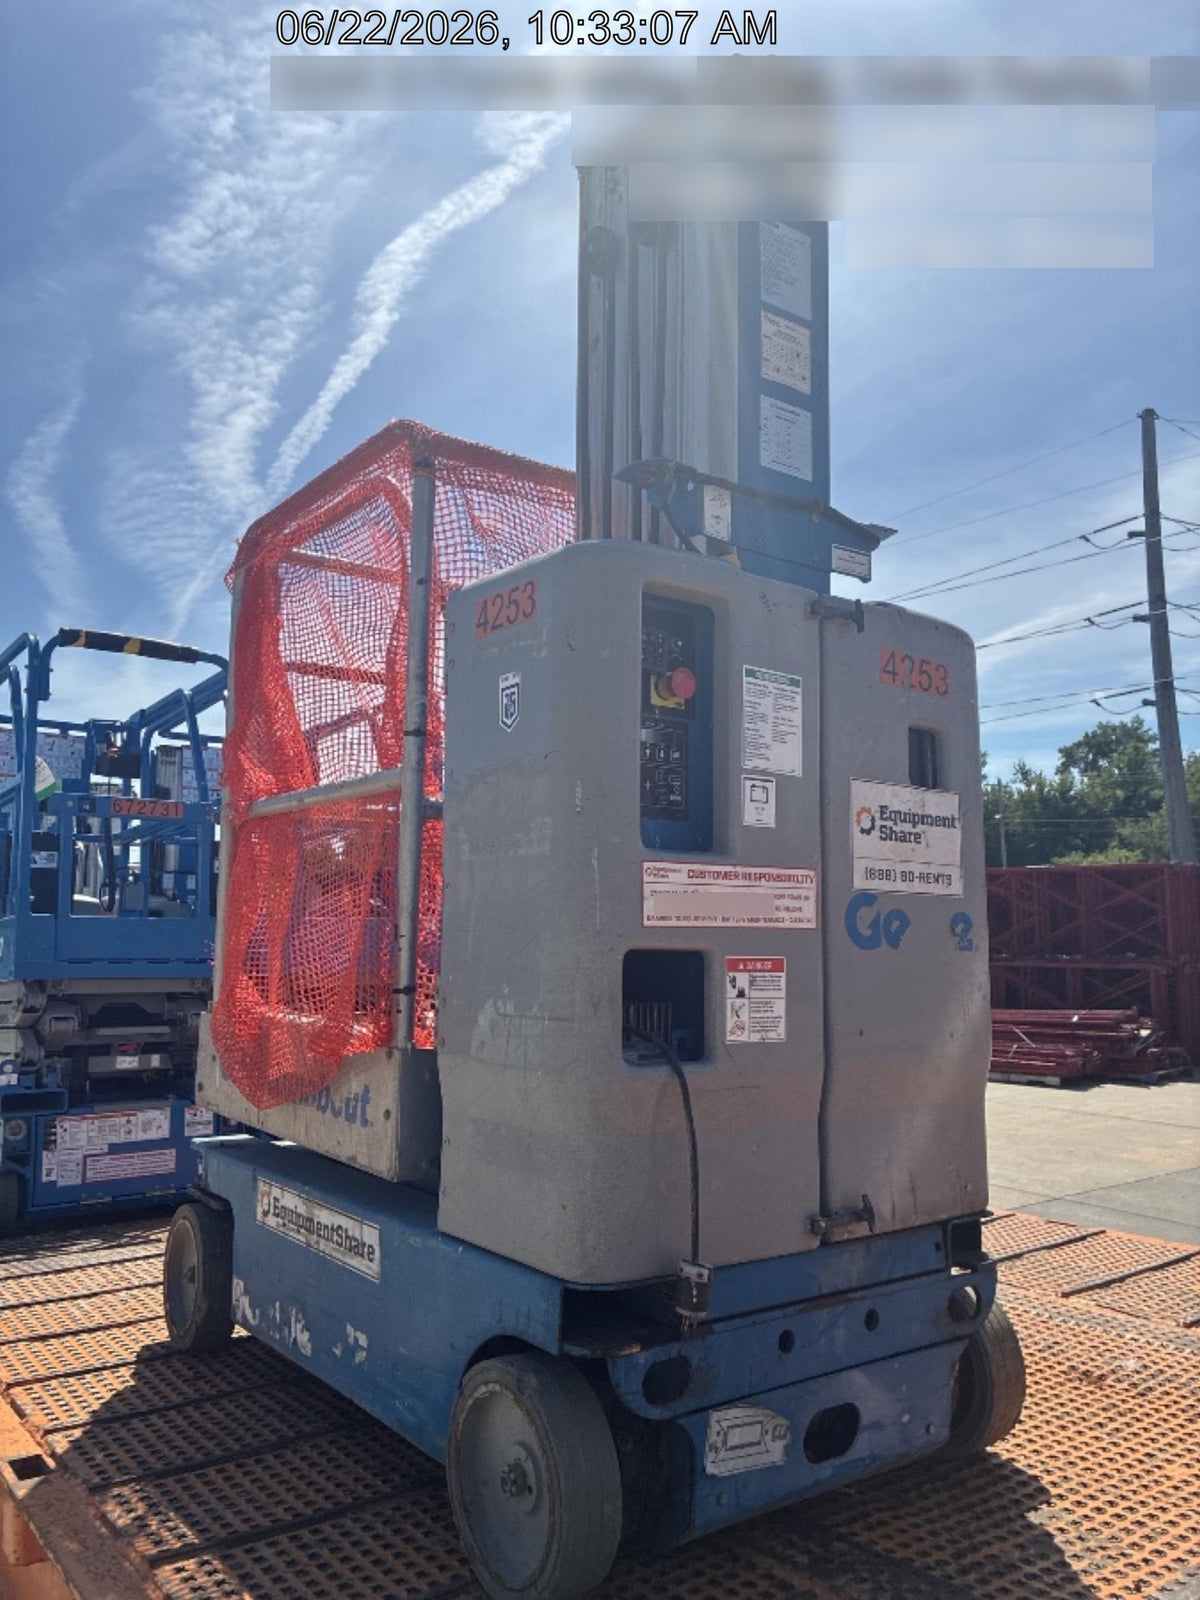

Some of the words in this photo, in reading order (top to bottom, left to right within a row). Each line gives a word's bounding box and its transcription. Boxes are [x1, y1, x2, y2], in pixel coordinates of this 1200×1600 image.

[476, 580, 537, 633] 4253
[113, 800, 179, 817] 672731
[879, 805, 957, 829] Equipment
[879, 826, 922, 844] Share
[687, 869, 740, 881] CUSTOMER
[272, 1196, 376, 1263] EquipmentShare
